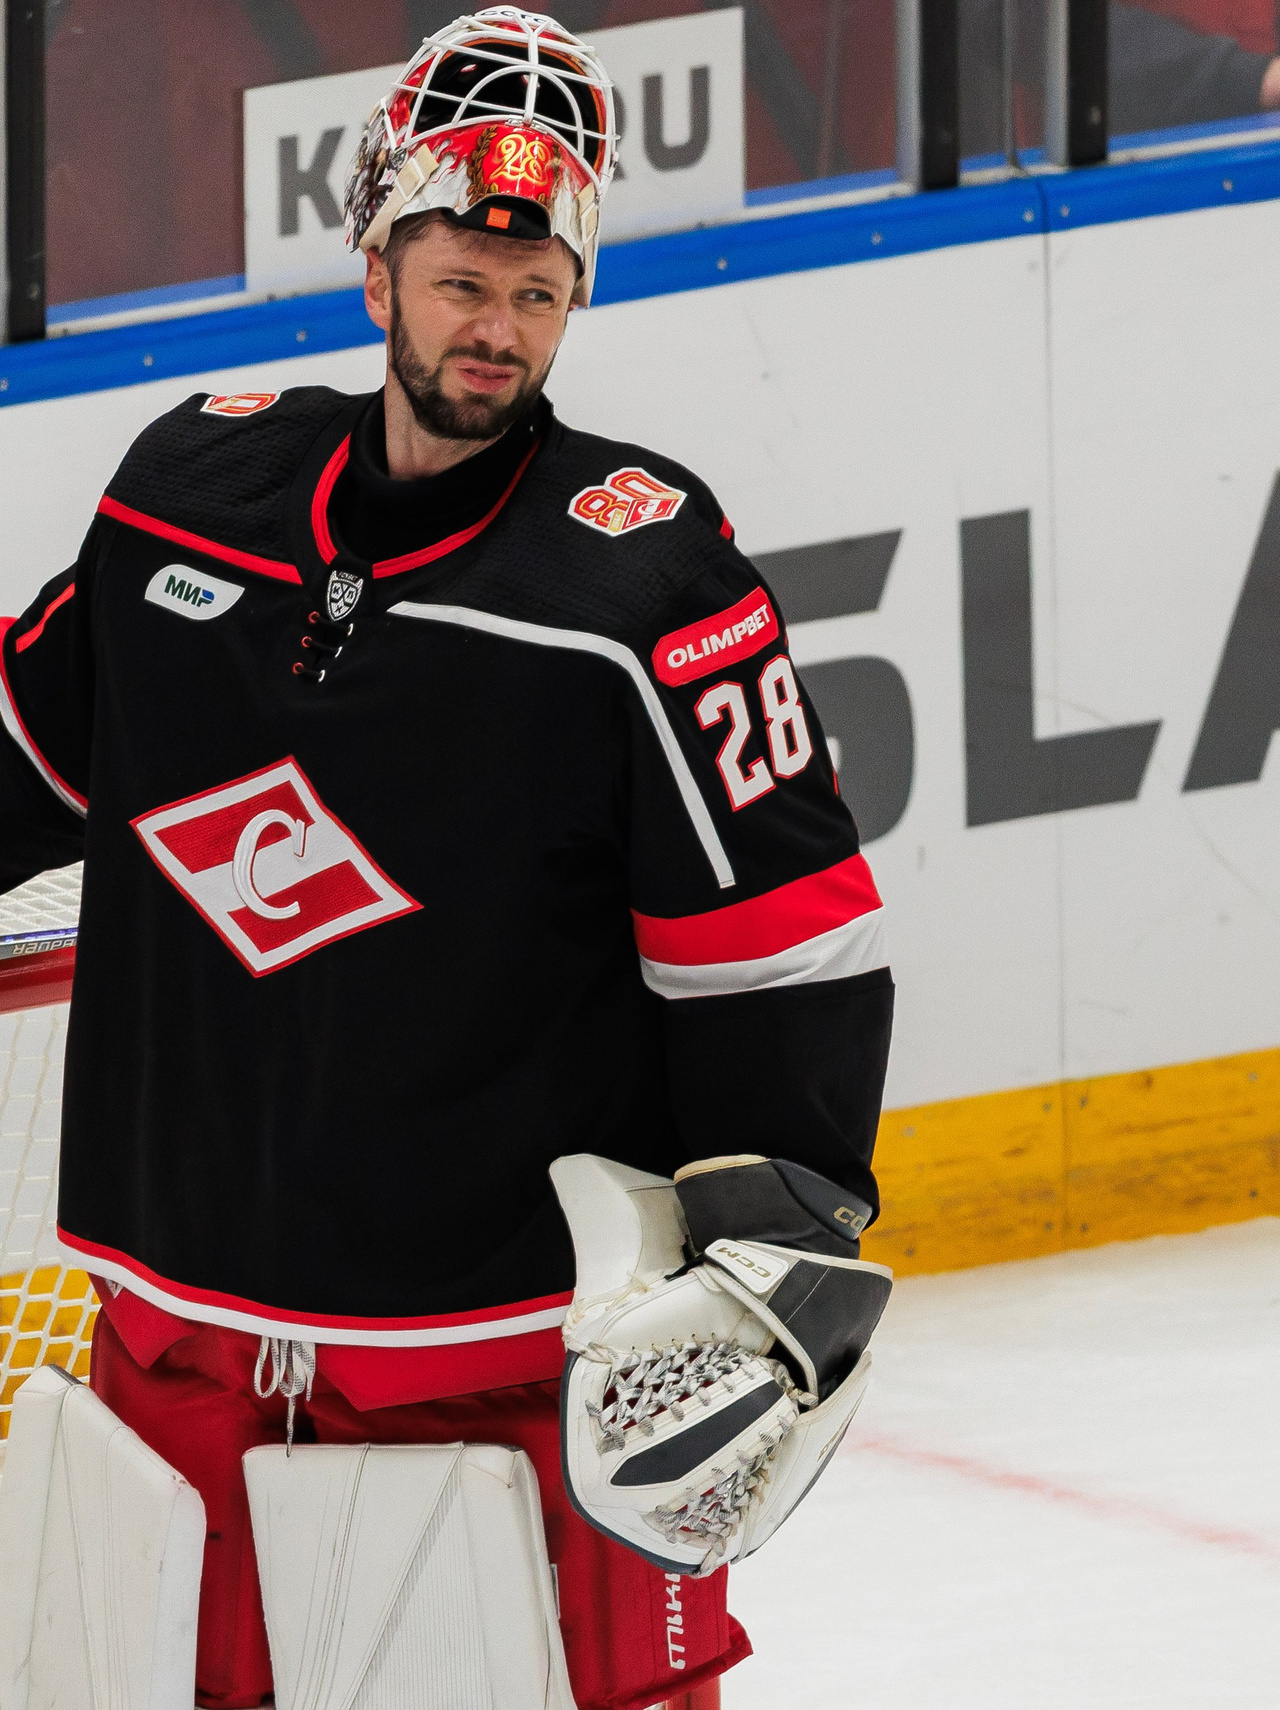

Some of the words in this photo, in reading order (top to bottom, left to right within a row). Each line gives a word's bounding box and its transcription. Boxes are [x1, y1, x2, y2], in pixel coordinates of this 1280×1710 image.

[489, 133, 550, 187] 28
[164, 574, 215, 608] МИР
[666, 603, 771, 669] OLIMPBET
[694, 653, 813, 812] 28
[716, 1247, 771, 1278] CCM
